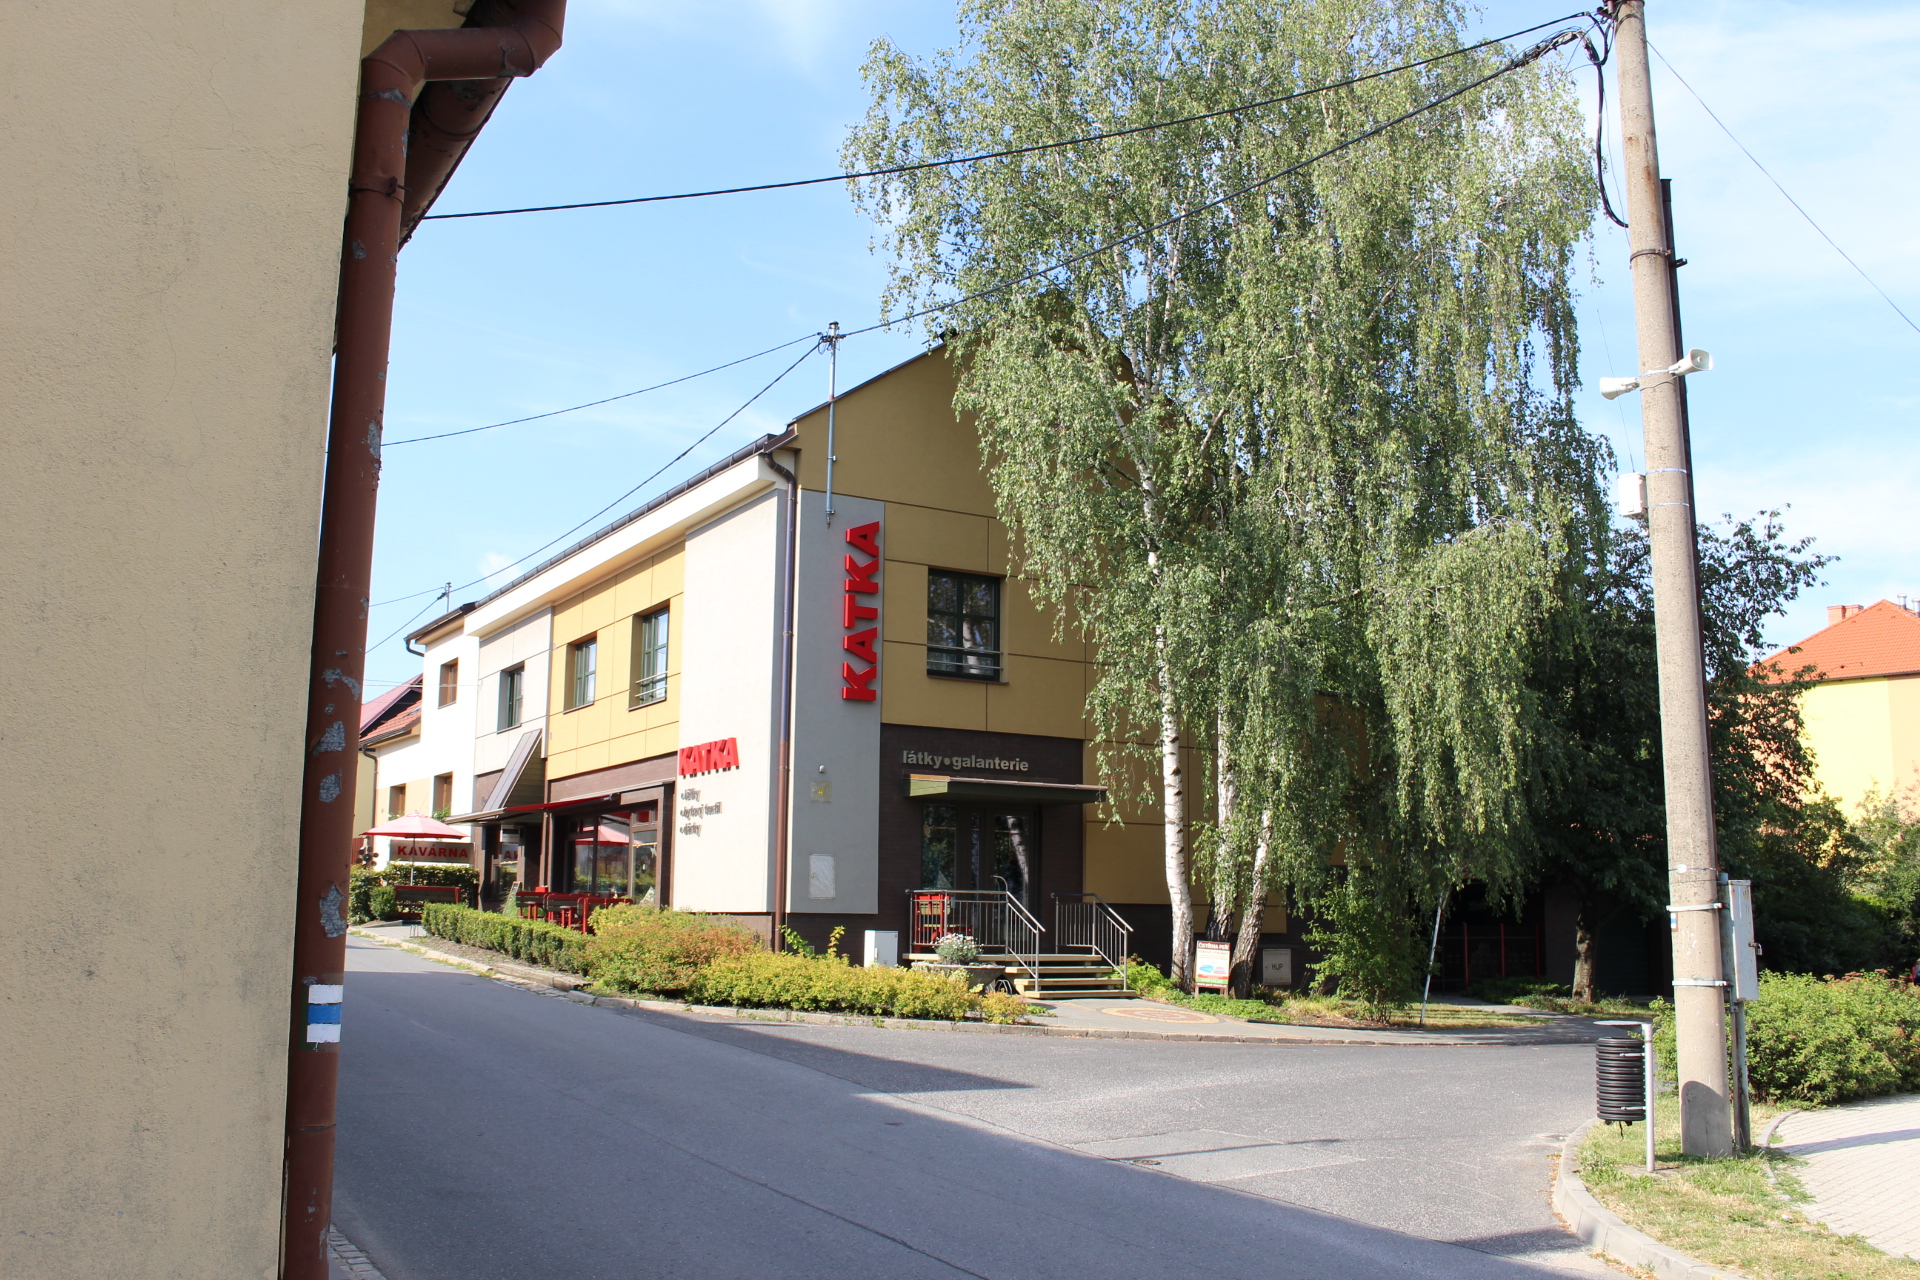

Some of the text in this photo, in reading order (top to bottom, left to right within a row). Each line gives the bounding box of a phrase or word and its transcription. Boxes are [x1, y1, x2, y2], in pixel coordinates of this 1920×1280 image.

[842, 521, 880, 701] KATKA
[679, 737, 740, 777] KATKA
[952, 754, 1029, 771] galanterie
[397, 844, 469, 858] KAVÁRNA
[1271, 963, 1284, 971] HUP
